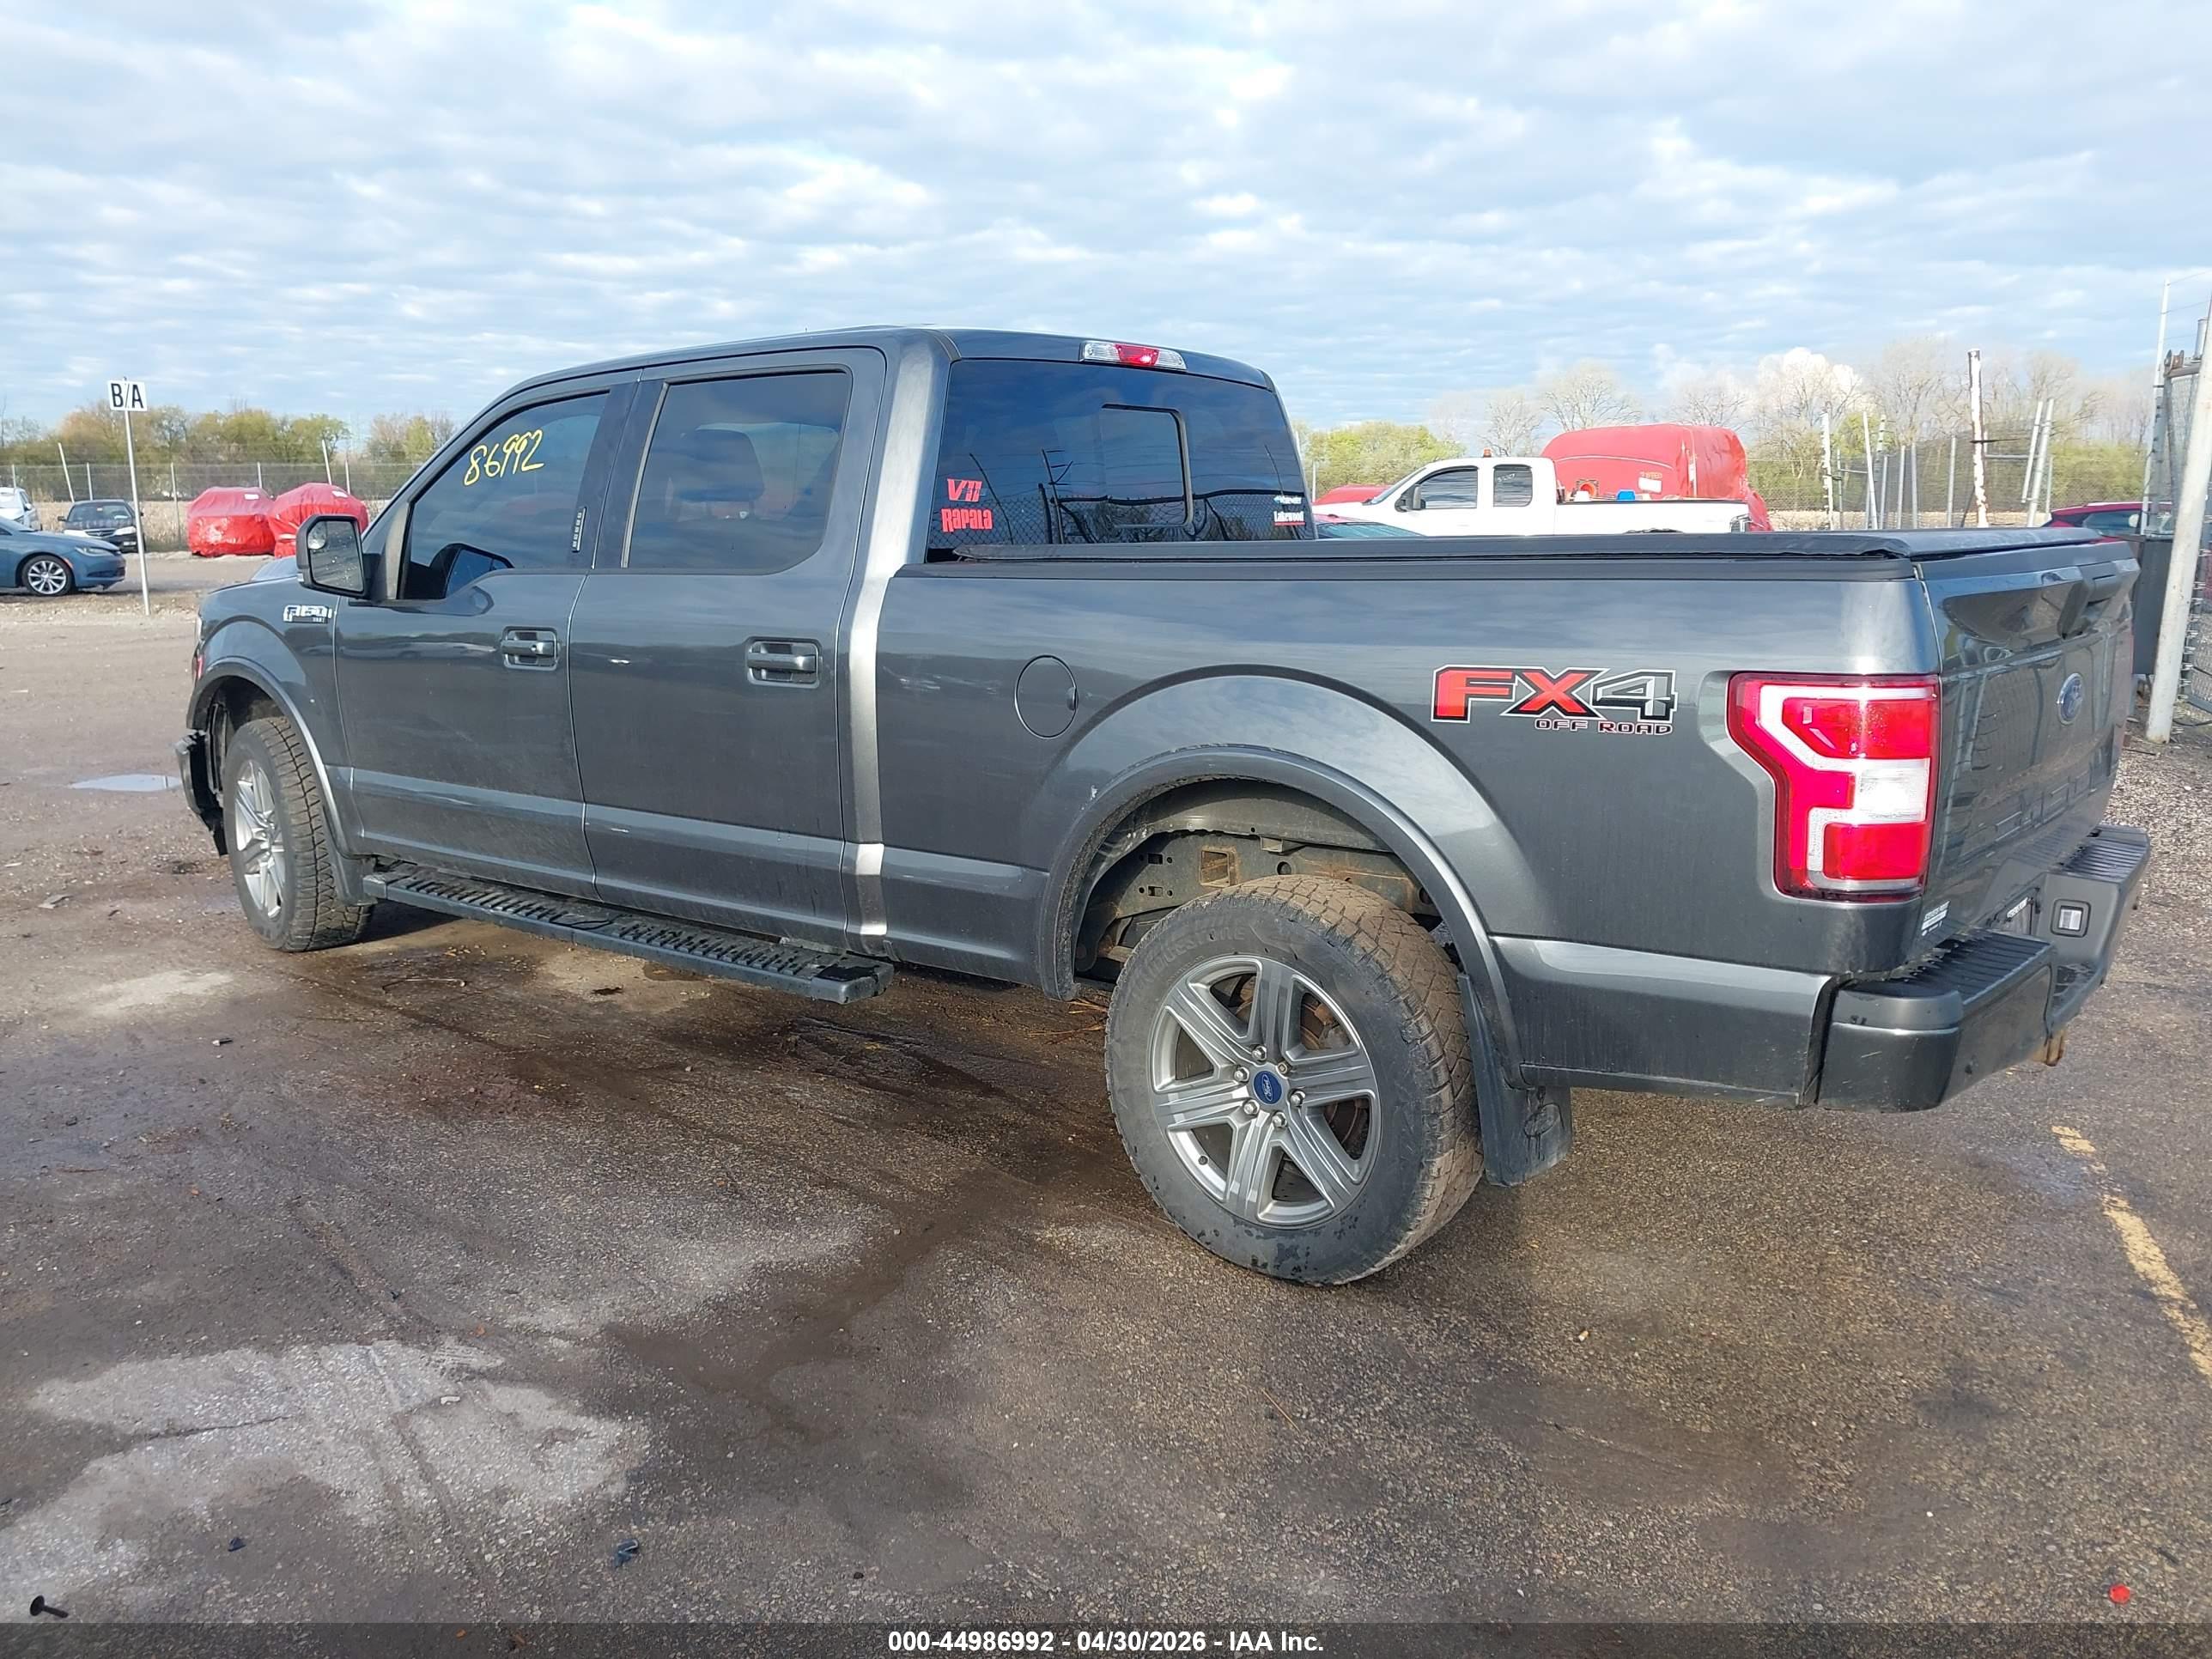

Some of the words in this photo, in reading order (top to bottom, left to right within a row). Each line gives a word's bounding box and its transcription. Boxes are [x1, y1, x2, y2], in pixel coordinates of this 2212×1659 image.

[111, 383, 143, 408] B/A
[464, 429, 544, 485] 86992
[1431, 665, 1678, 723] FX4
[1535, 719, 1588, 731] OFF
[1598, 720, 1673, 735] ROAD
